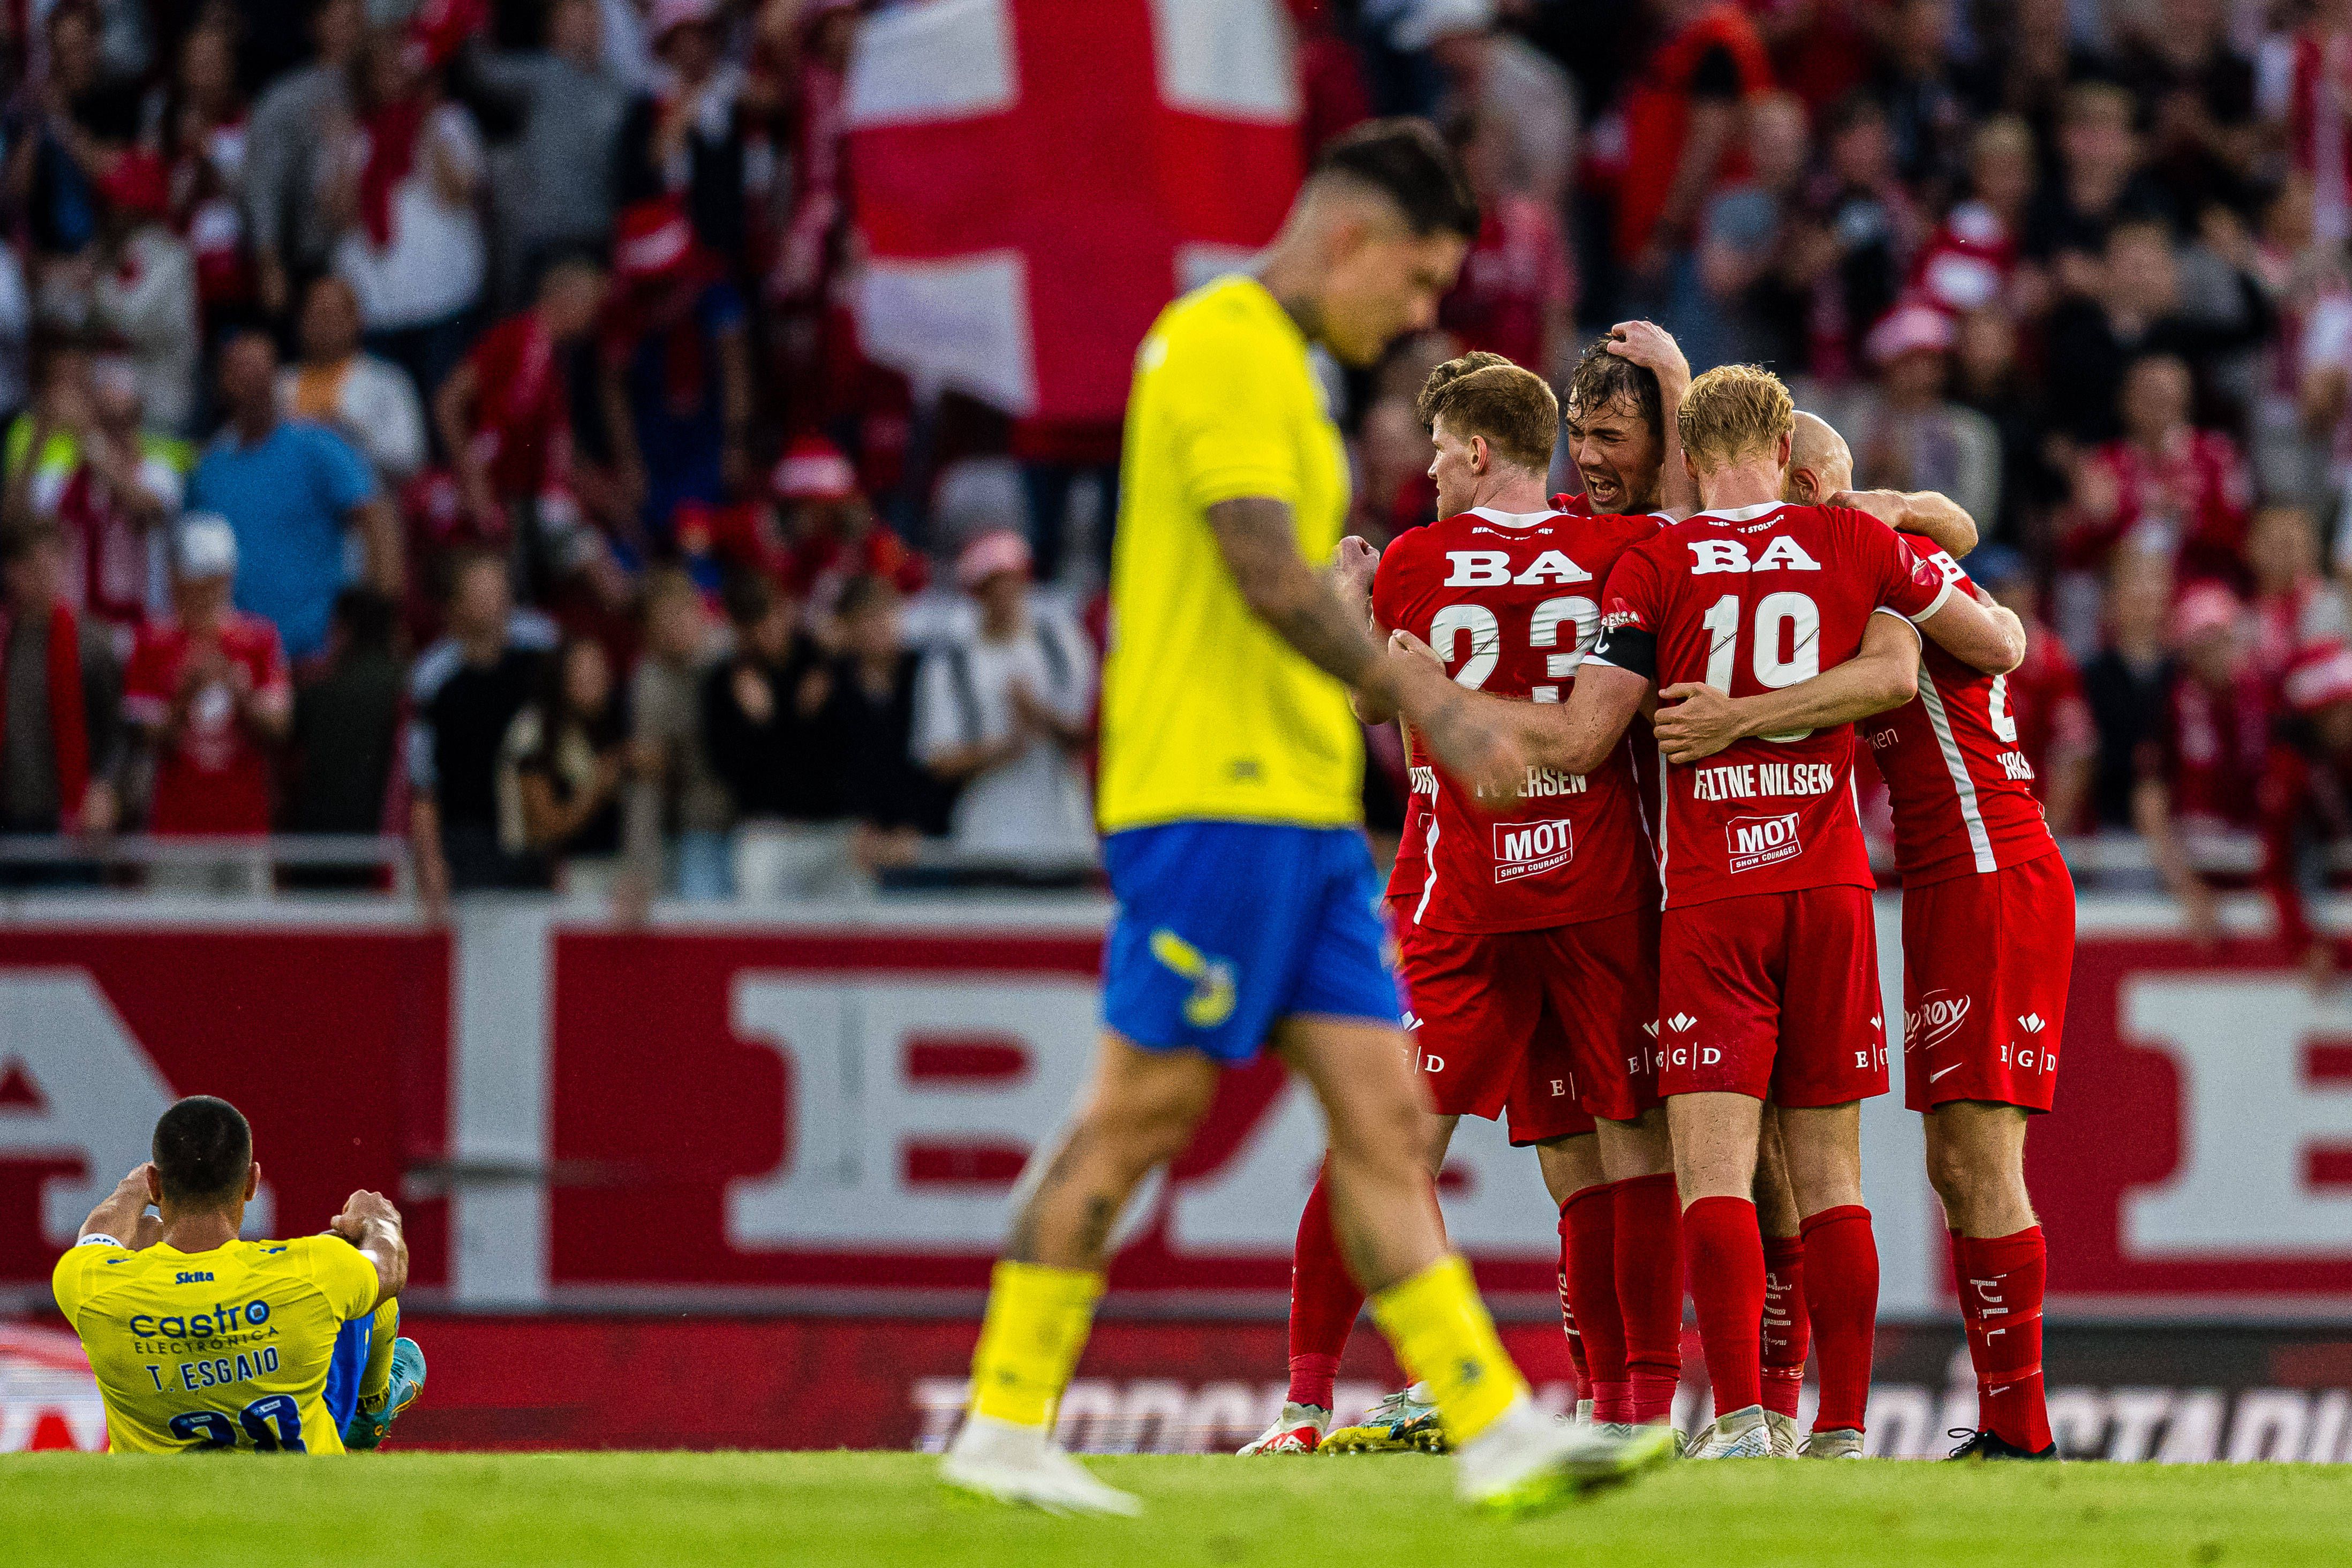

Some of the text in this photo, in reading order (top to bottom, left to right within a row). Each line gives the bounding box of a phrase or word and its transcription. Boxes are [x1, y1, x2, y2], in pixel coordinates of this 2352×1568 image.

[1444, 550, 1592, 587] BA
[1687, 536, 1821, 575] BA
[1760, 763, 1834, 796] NILSEN
[1505, 819, 1570, 861] MOT
[1737, 815, 1795, 853] MOT
[1501, 854, 1567, 877] SHOW COURAGE!
[1736, 846, 1796, 868] SHOW COURAGE!
[175, 1272, 214, 1285] Skita
[130, 1300, 270, 1338] castro
[146, 1346, 280, 1392] T. ESGAIO
